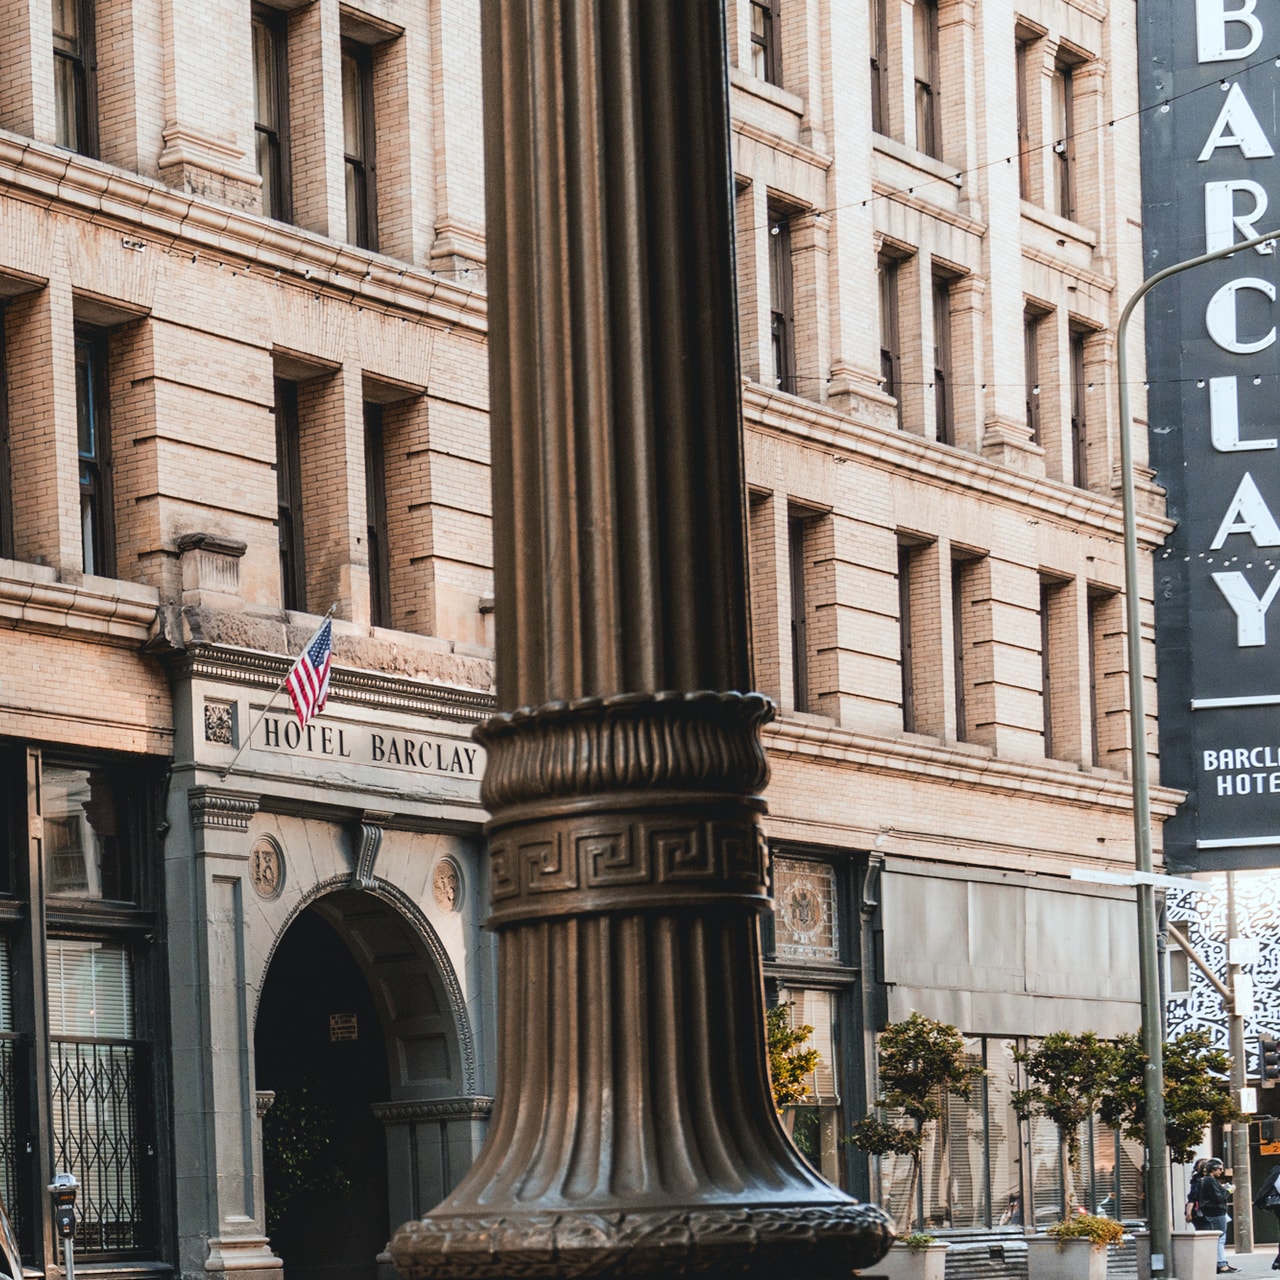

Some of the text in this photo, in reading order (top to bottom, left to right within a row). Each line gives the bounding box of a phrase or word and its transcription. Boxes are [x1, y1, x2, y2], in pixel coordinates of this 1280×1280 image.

[1196, 0, 1280, 647] BARCLAY
[263, 717, 477, 775] HOTEL BARCLAY
[1203, 746, 1280, 771] BARCL
[1217, 772, 1280, 796] HOTE
